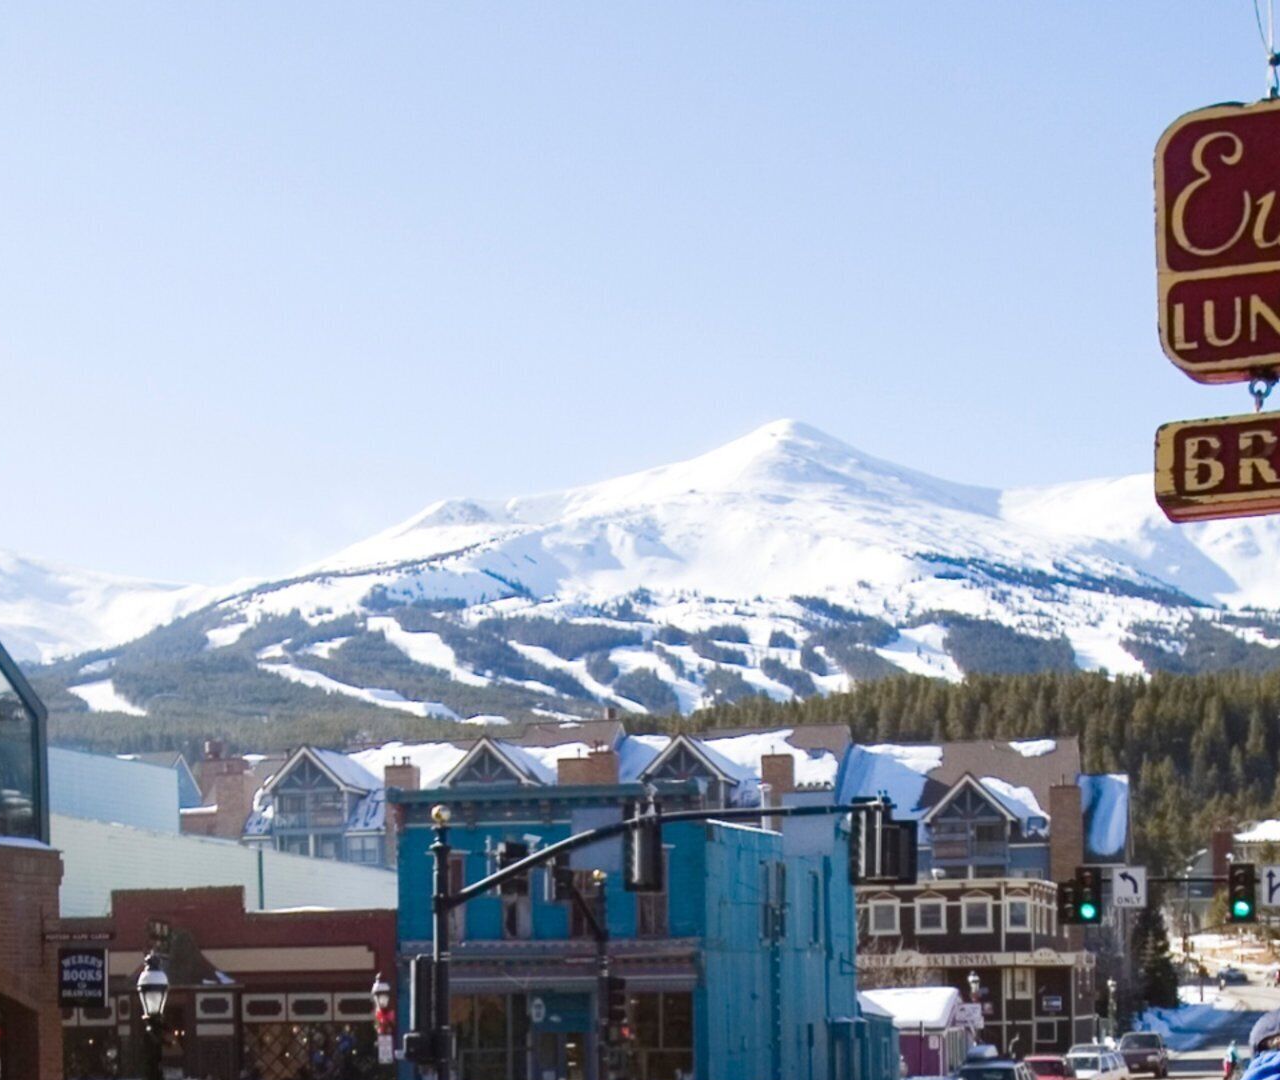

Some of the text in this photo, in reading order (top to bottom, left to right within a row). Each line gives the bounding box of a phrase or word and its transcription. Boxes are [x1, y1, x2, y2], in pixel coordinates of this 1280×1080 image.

[1117, 896, 1141, 905] ONLY
[951, 954, 997, 966] RENTAL
[63, 969, 102, 981] BOOKS
